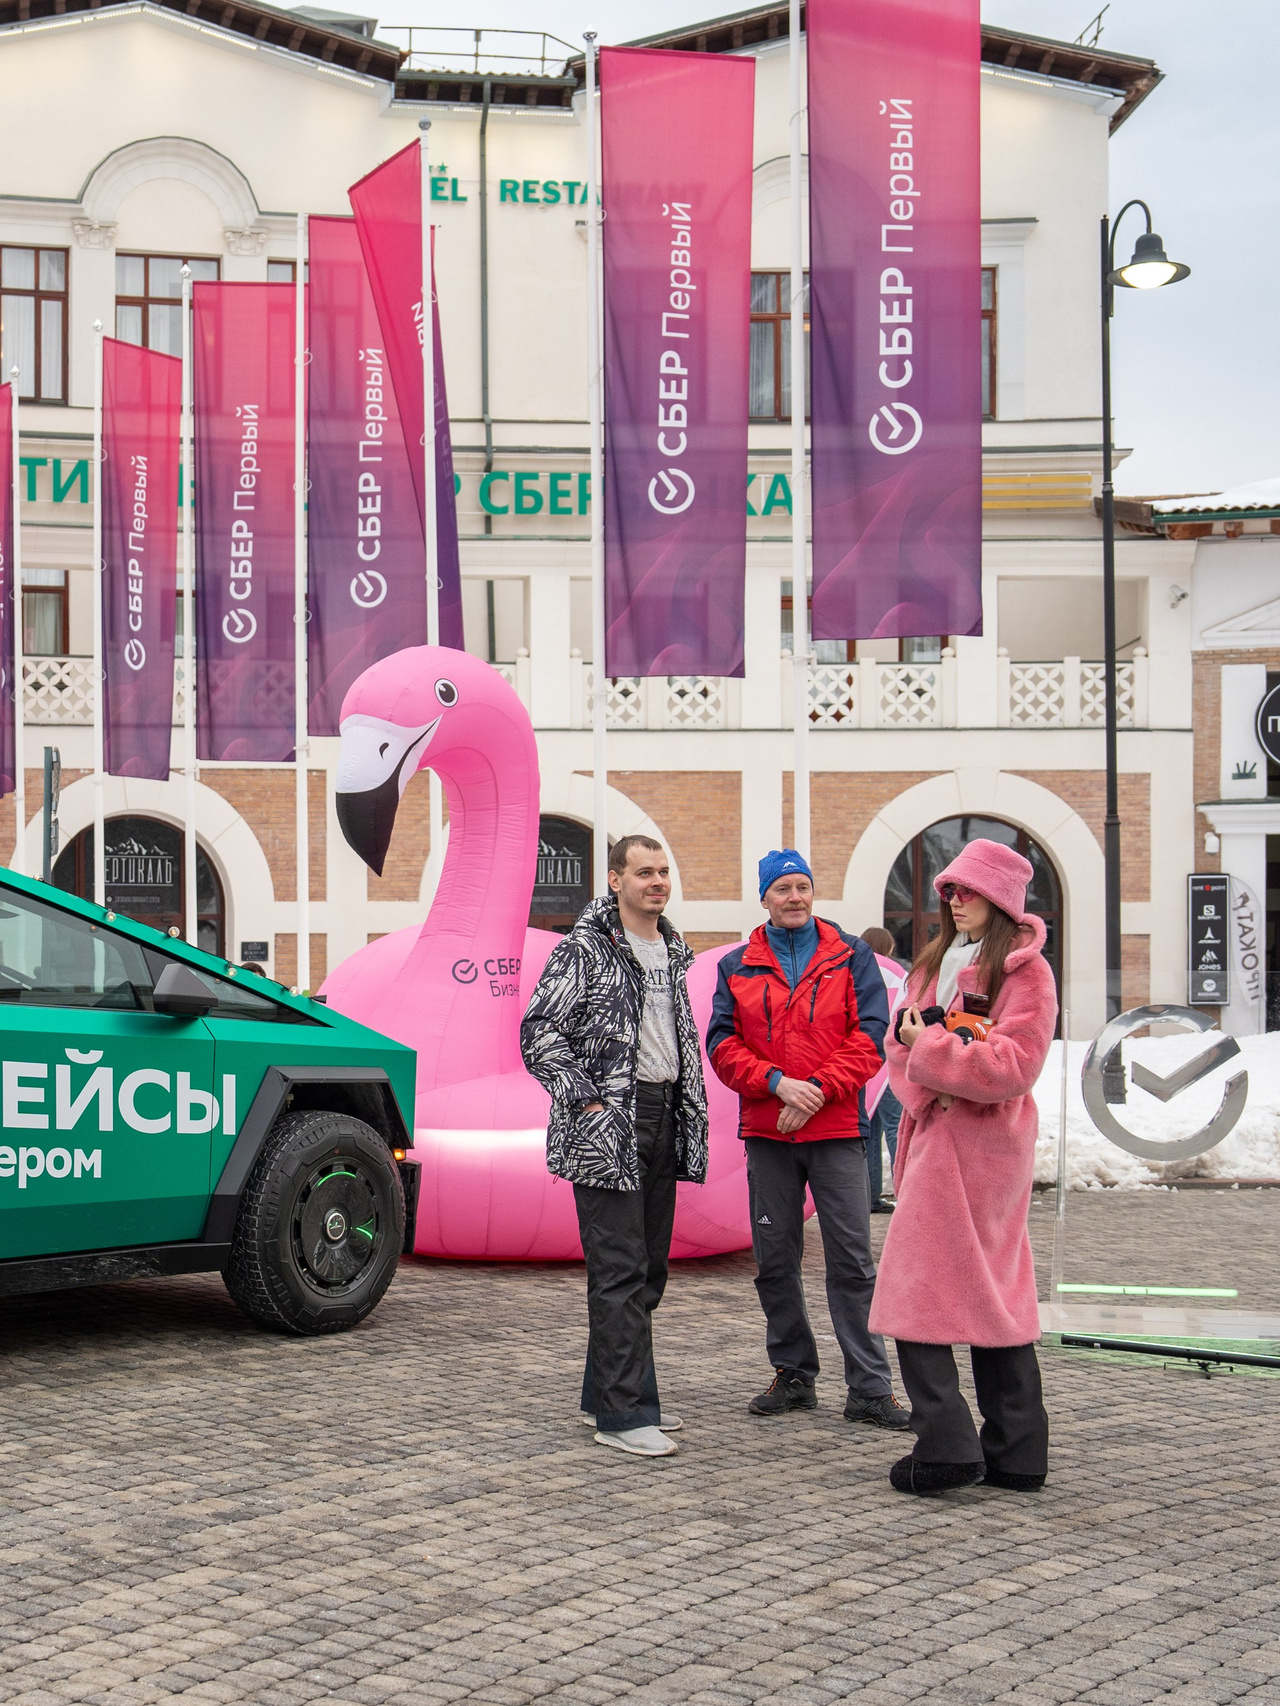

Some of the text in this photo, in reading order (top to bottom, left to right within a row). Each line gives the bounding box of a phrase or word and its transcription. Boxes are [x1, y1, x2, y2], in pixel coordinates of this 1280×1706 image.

[657, 202, 698, 457] СБЕР Первый
[879, 98, 922, 388] СБЕР Первый
[128, 455, 149, 632] СБЕР Первый
[229, 404, 262, 601] СБЕР Первый
[357, 348, 389, 562] СБЕР Первый
[104, 857, 172, 884] ЕРТИКАЛЬ
